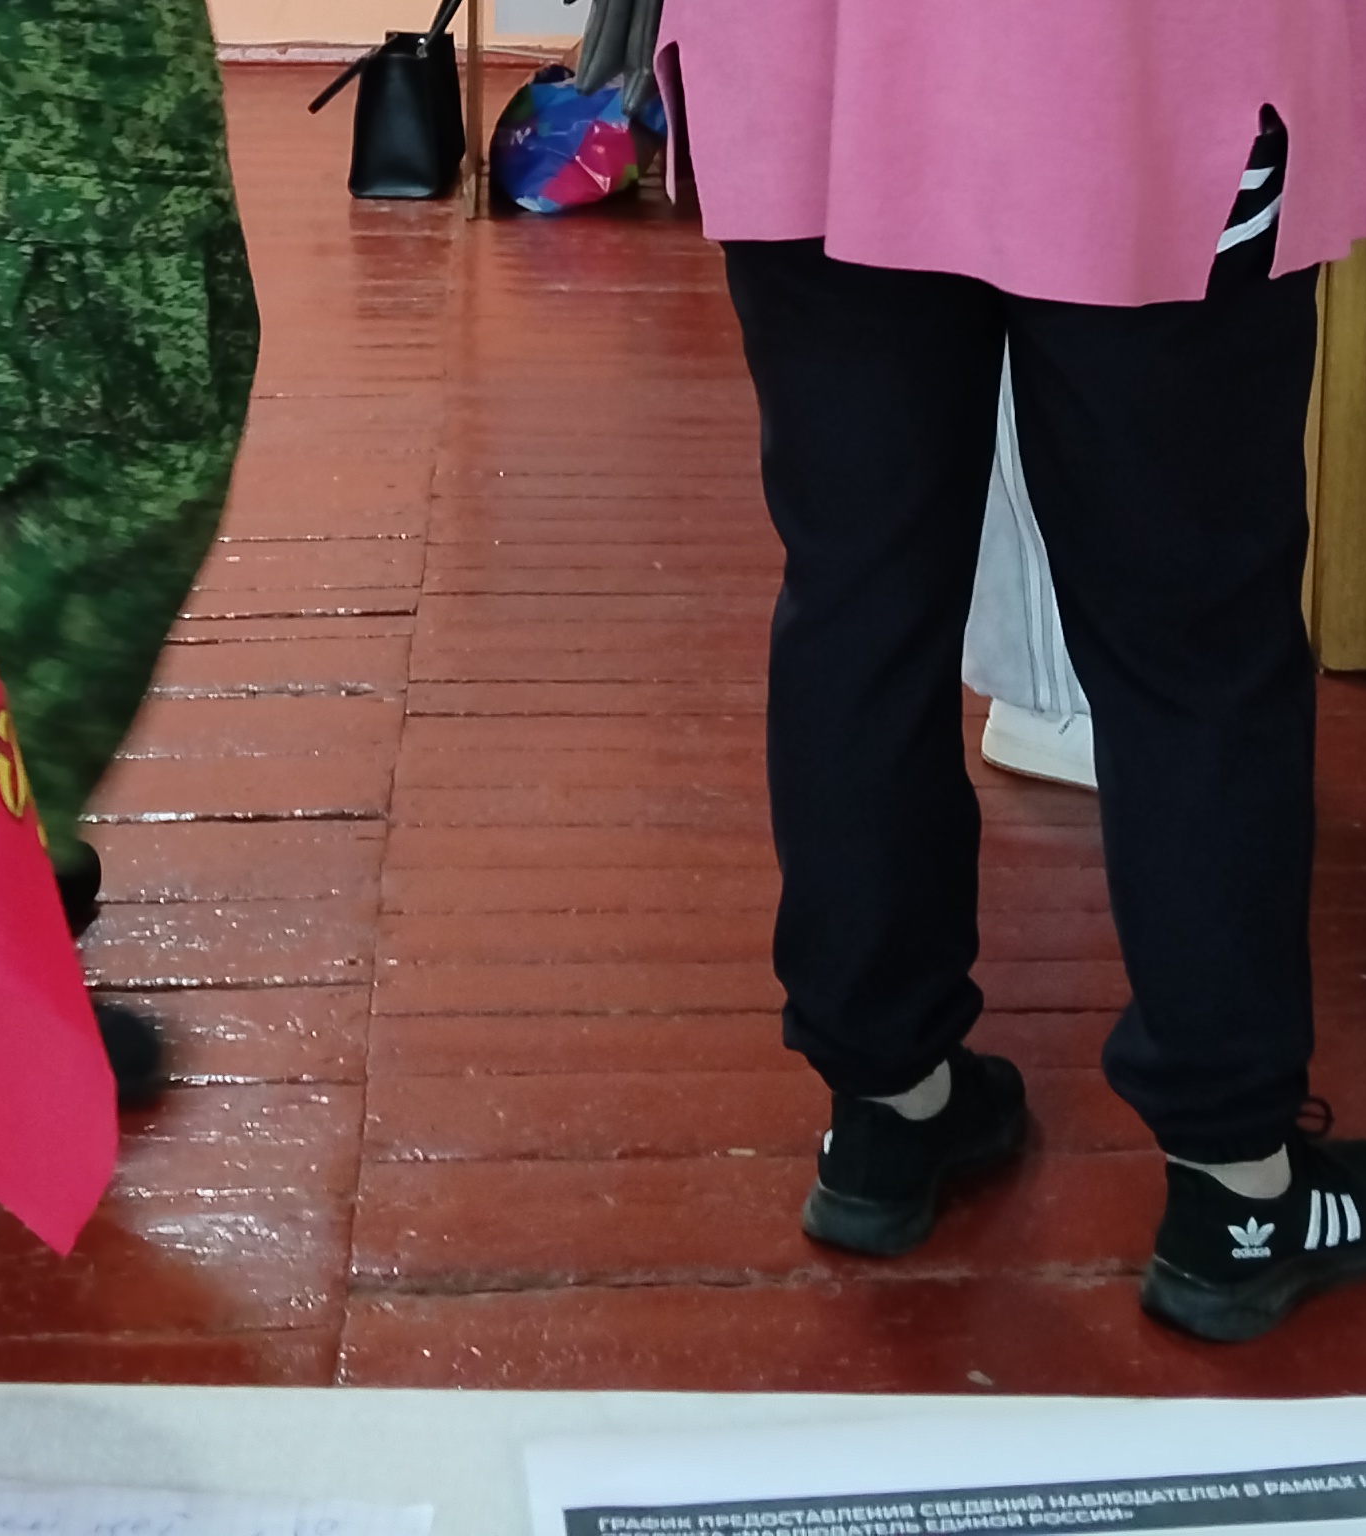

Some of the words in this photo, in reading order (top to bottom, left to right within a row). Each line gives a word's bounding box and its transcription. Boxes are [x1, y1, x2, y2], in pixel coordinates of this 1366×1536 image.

[598, 1515, 692, 1532] ГРАФИК
[698, 1503, 916, 1529] ПРЕДОСТАВЛЕНИЯ
[920, 1493, 1044, 1517] СВЕДЕНИЙ
[1049, 1484, 1240, 1509] НАБЛЮДАТЕЛЕМ
[1243, 1481, 1260, 1497] В
[1263, 1475, 1356, 1496] РАМКАХ
